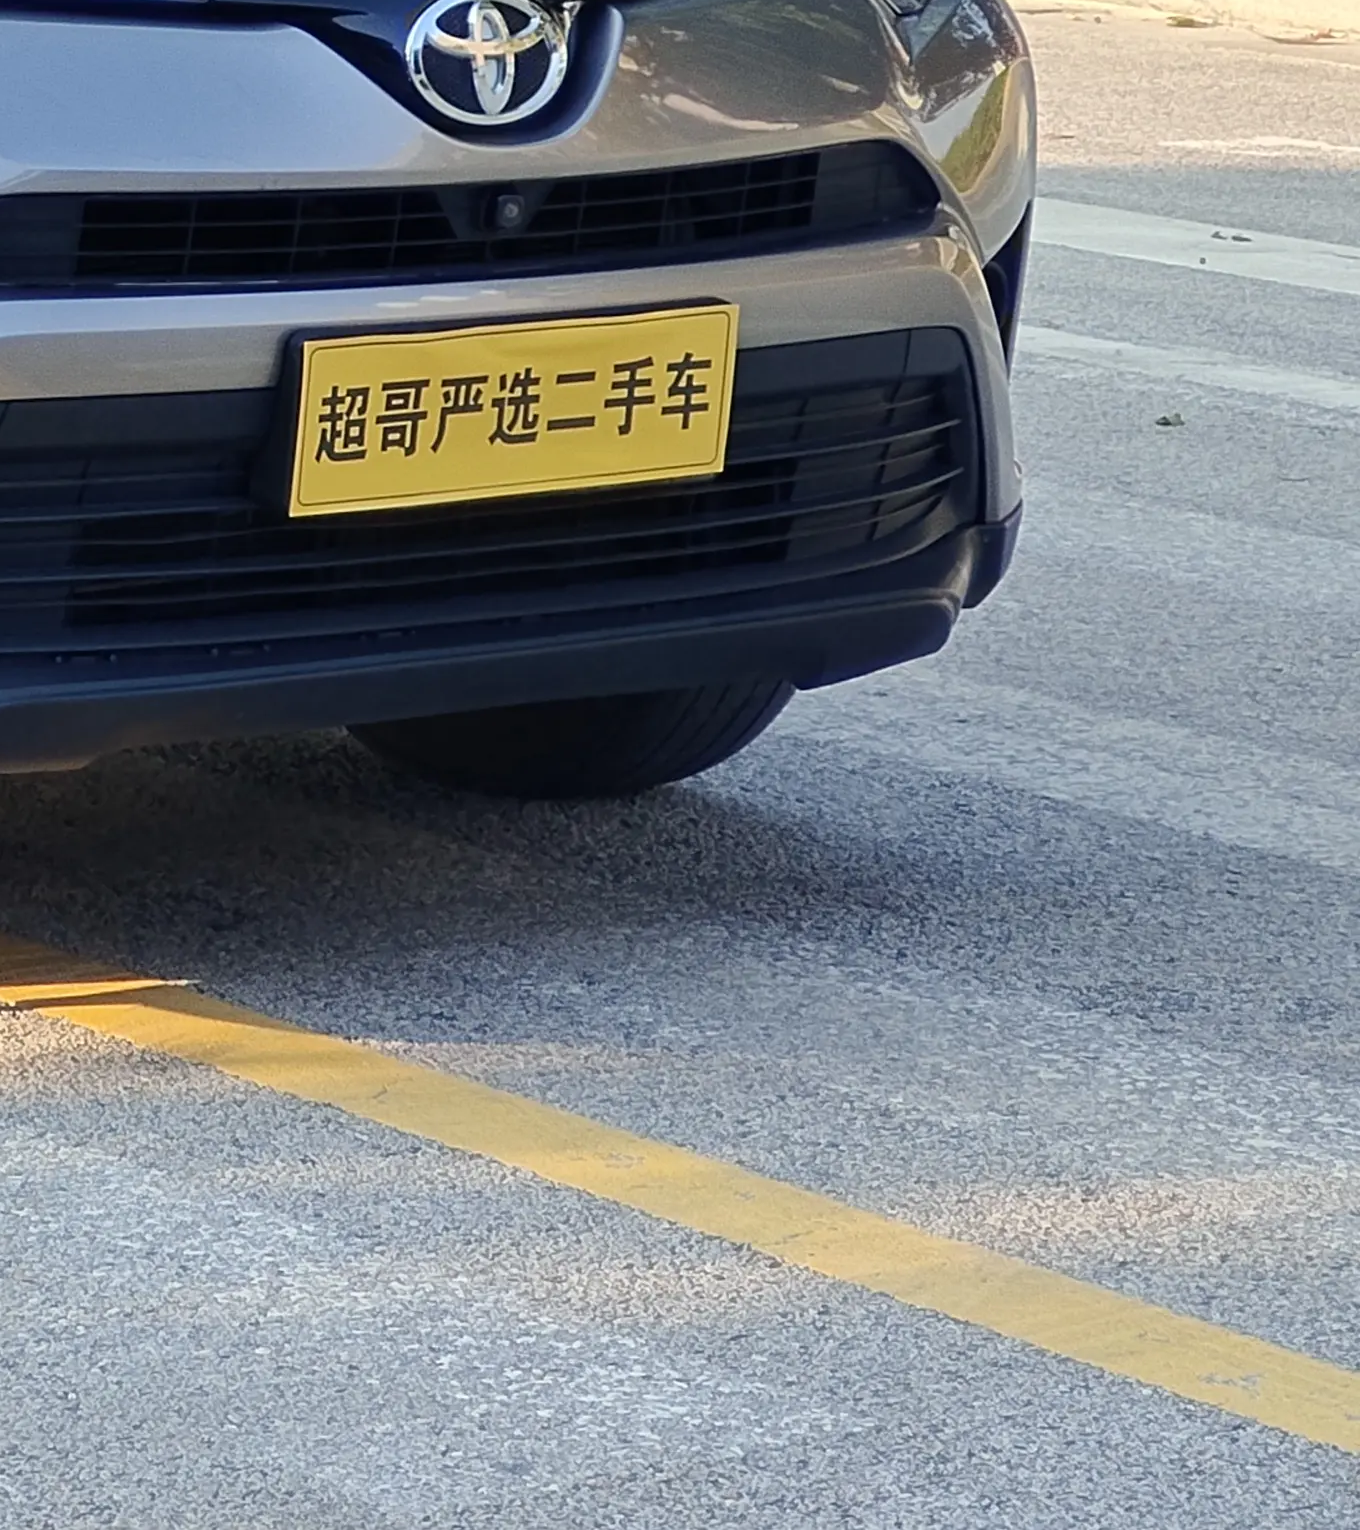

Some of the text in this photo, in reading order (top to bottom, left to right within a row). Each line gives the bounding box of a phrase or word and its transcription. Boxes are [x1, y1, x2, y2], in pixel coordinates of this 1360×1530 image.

[314, 352, 713, 463] 超哥严选二手车
